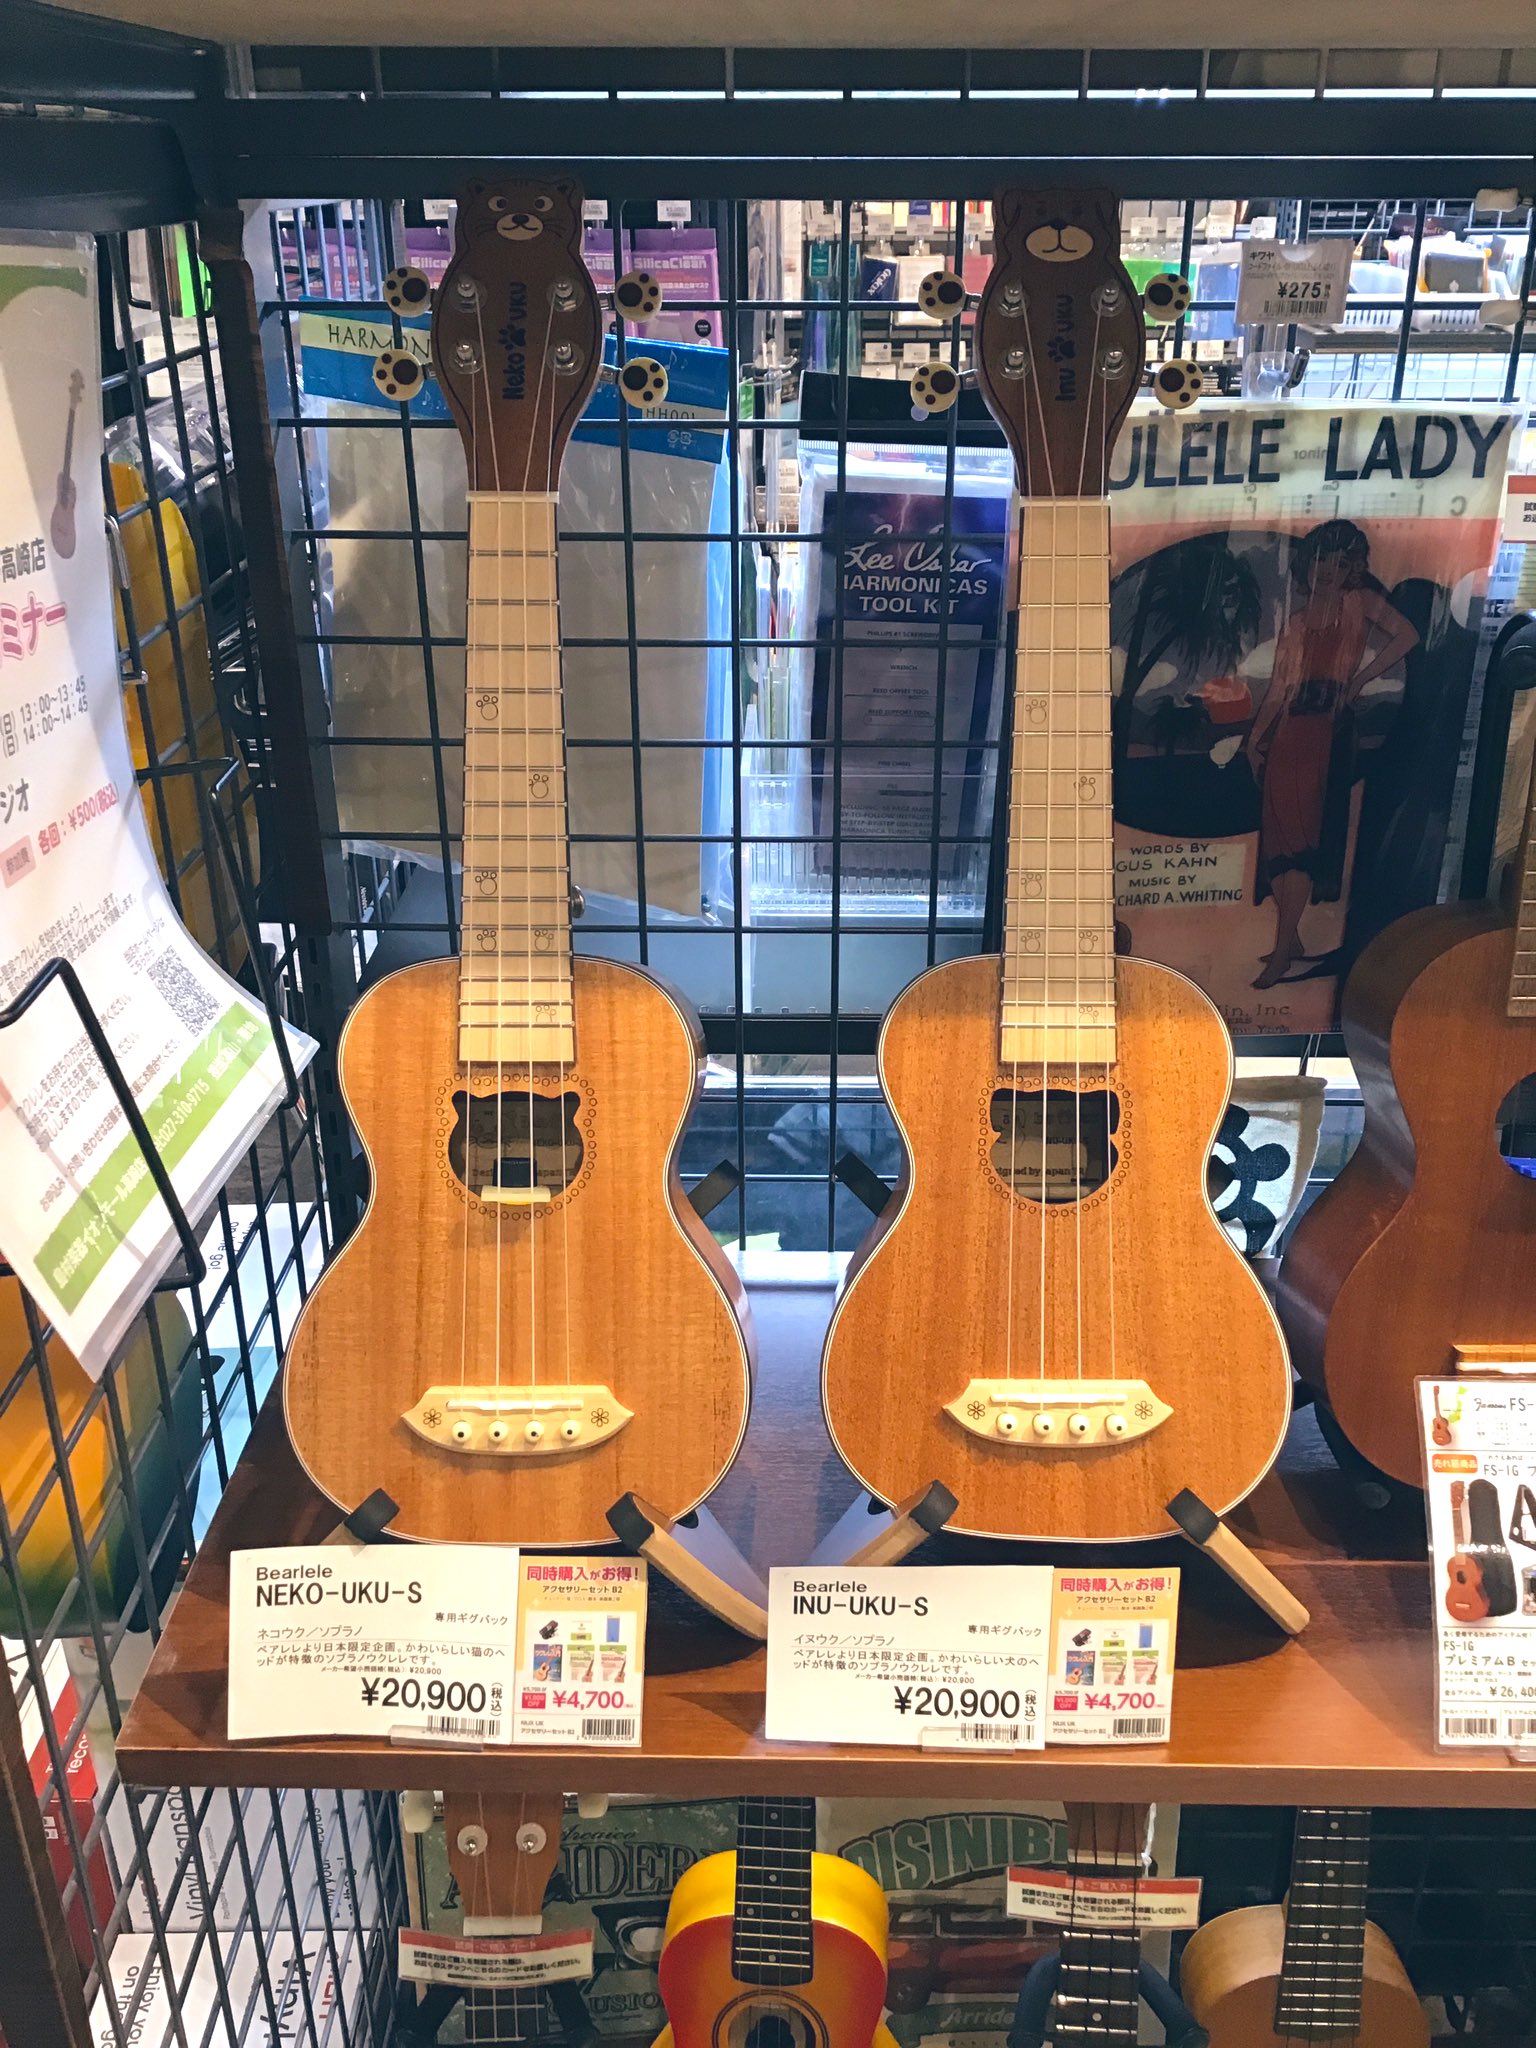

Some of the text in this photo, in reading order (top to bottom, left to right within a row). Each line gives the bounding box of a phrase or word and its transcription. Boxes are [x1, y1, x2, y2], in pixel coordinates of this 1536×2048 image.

[1277, 282, 1322, 299] ¥275
[1108, 414, 1516, 490] ULELE LADY
[859, 596, 959, 615] TOOL KT
[1131, 842, 1211, 856] WORDS BY
[1116, 857, 1218, 872] GUS KAHN
[1129, 874, 1197, 888] MUSIC BY
[1118, 892, 1160, 906] CHARD
[207, 1253, 224, 1270] go!
[1484, 1465, 1519, 1476] FS-1G
[256, 1564, 333, 1581] Bearlele
[527, 1565, 640, 1582] 同時購入がお得!
[542, 1586, 610, 1594] アクセサリーセット
[793, 1580, 867, 1593] Bearlele
[1060, 1577, 1172, 1593] 同時購入がお得!
[256, 1581, 422, 1607] NEKO-UKU-S
[793, 1596, 929, 1617] INU-UKU-S
[435, 1612, 508, 1626] 専用ギグバック
[968, 1624, 1043, 1638] 専用ギグバック
[1443, 1641, 1475, 1651] FS-1G
[361, 1677, 487, 1713] ¥20,900
[553, 1690, 624, 1711] ¥4,700
[894, 1685, 1020, 1719] ¥20,900
[1085, 1692, 1155, 1711] ¥4,700
[122, 1965, 140, 1989] on
